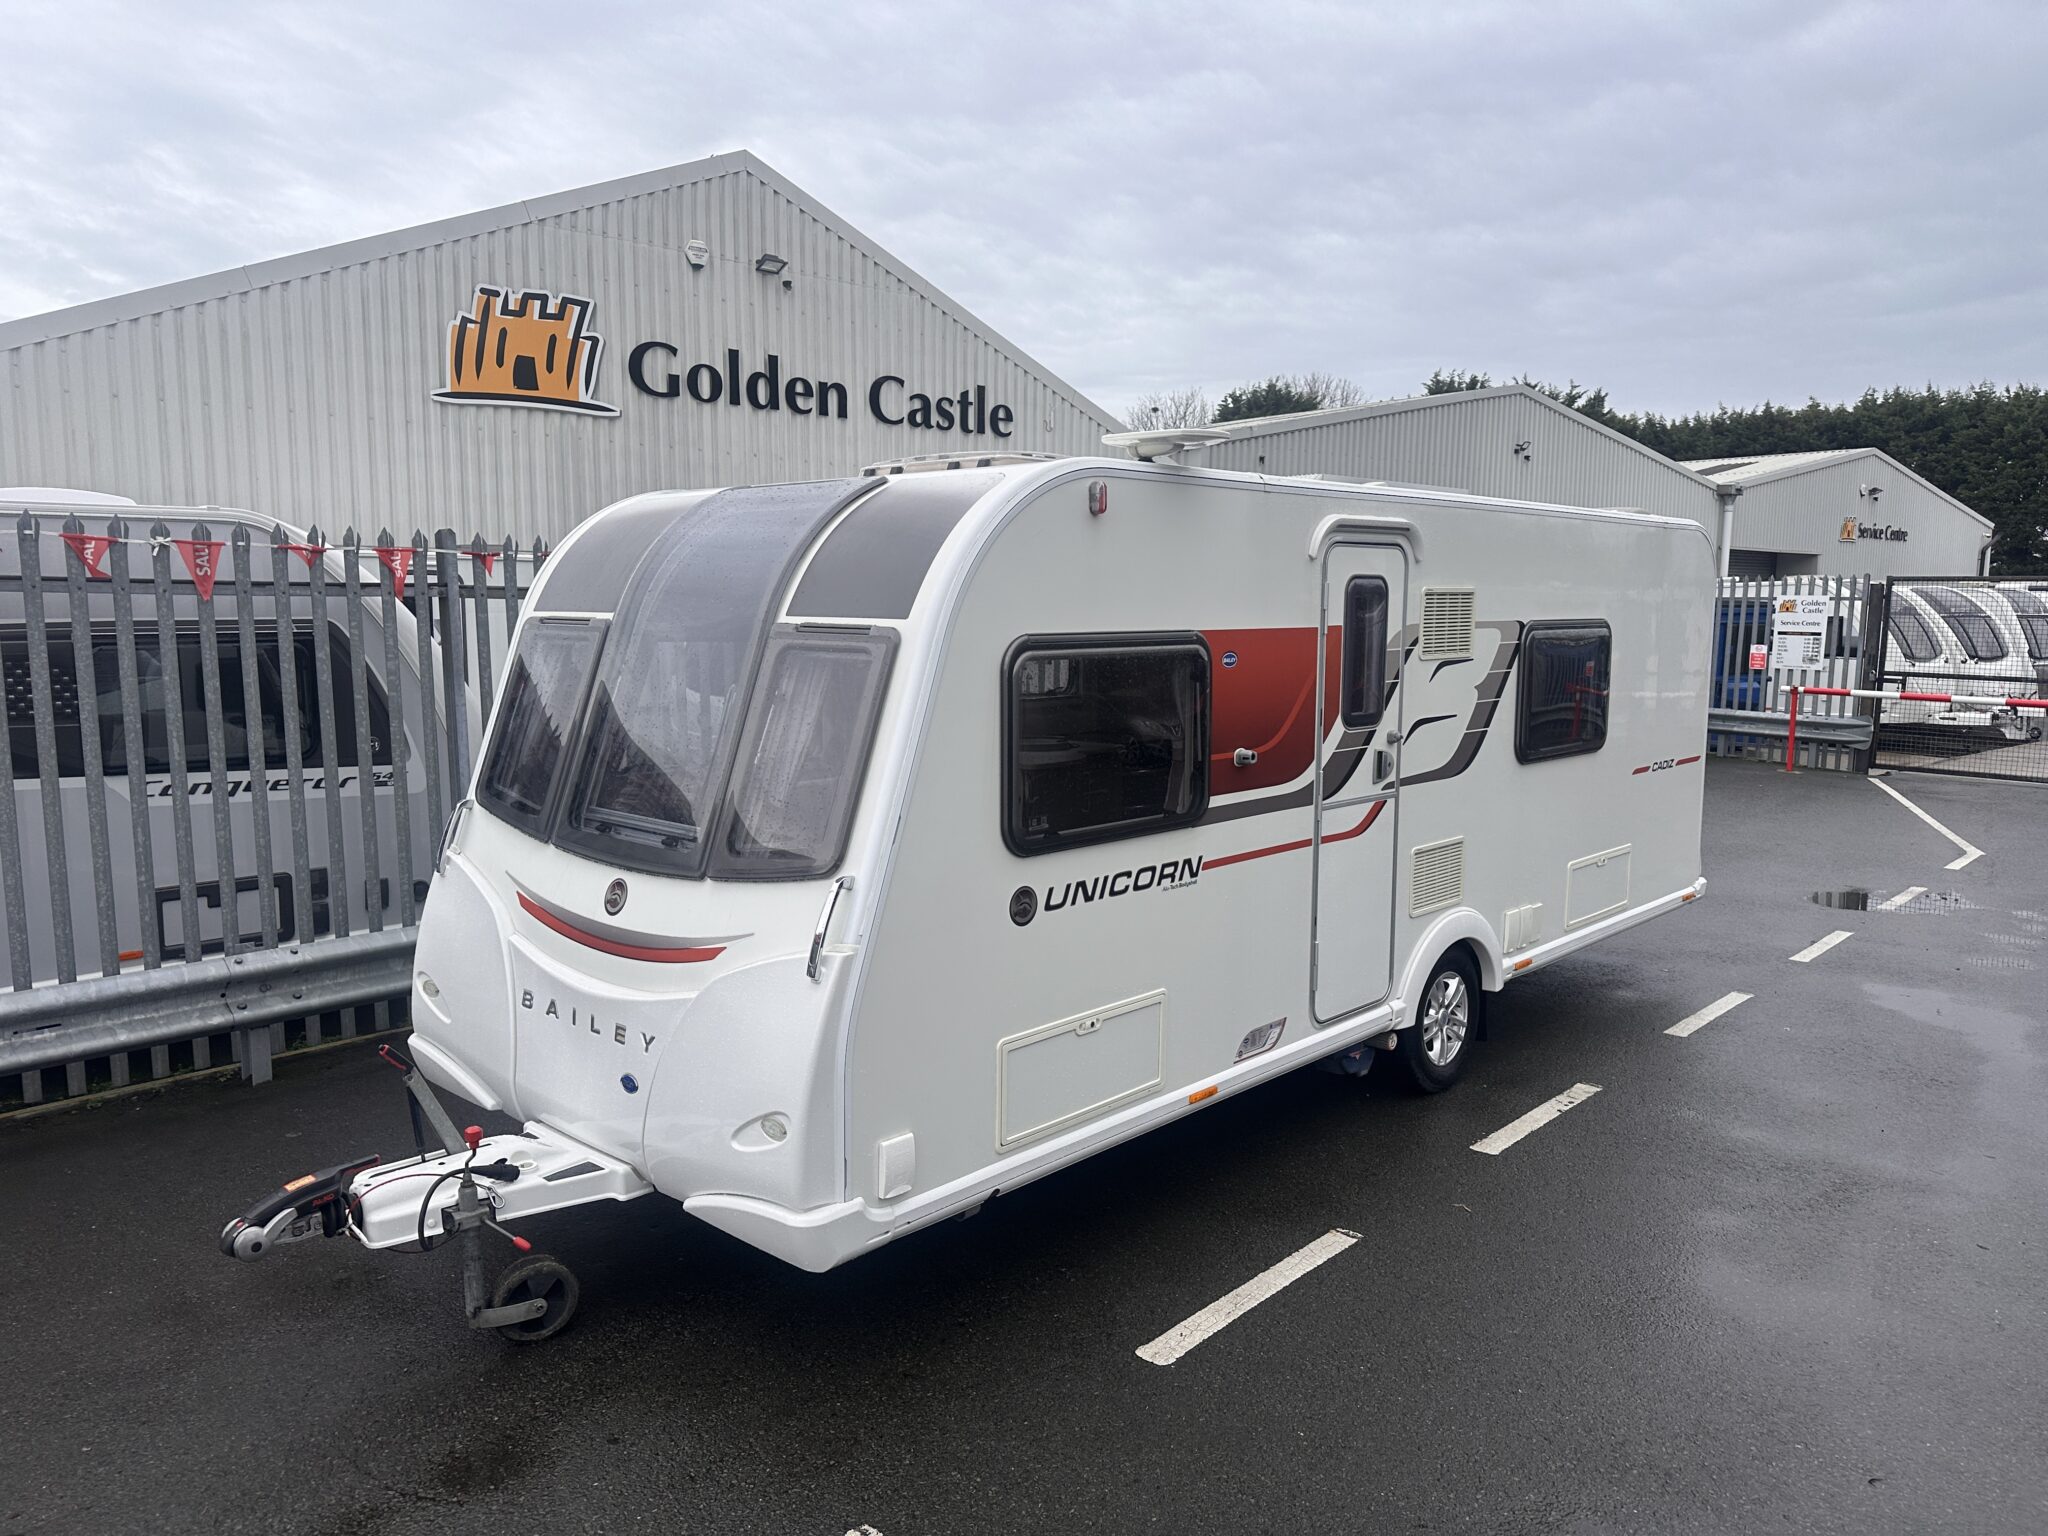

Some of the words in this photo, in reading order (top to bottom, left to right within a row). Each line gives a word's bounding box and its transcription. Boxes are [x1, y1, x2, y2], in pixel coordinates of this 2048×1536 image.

[627, 340, 849, 420] Golden
[868, 374, 1014, 438] Castle
[1857, 522, 1884, 540] Service
[1885, 524, 1908, 542] Centre
[196, 543, 212, 577] SAL
[389, 550, 404, 578] SAL
[1801, 599, 1827, 607] Golden
[1651, 758, 1675, 772] CADIZ
[1043, 854, 1204, 912] UNICORN
[520, 988, 656, 1054] BAILEY
